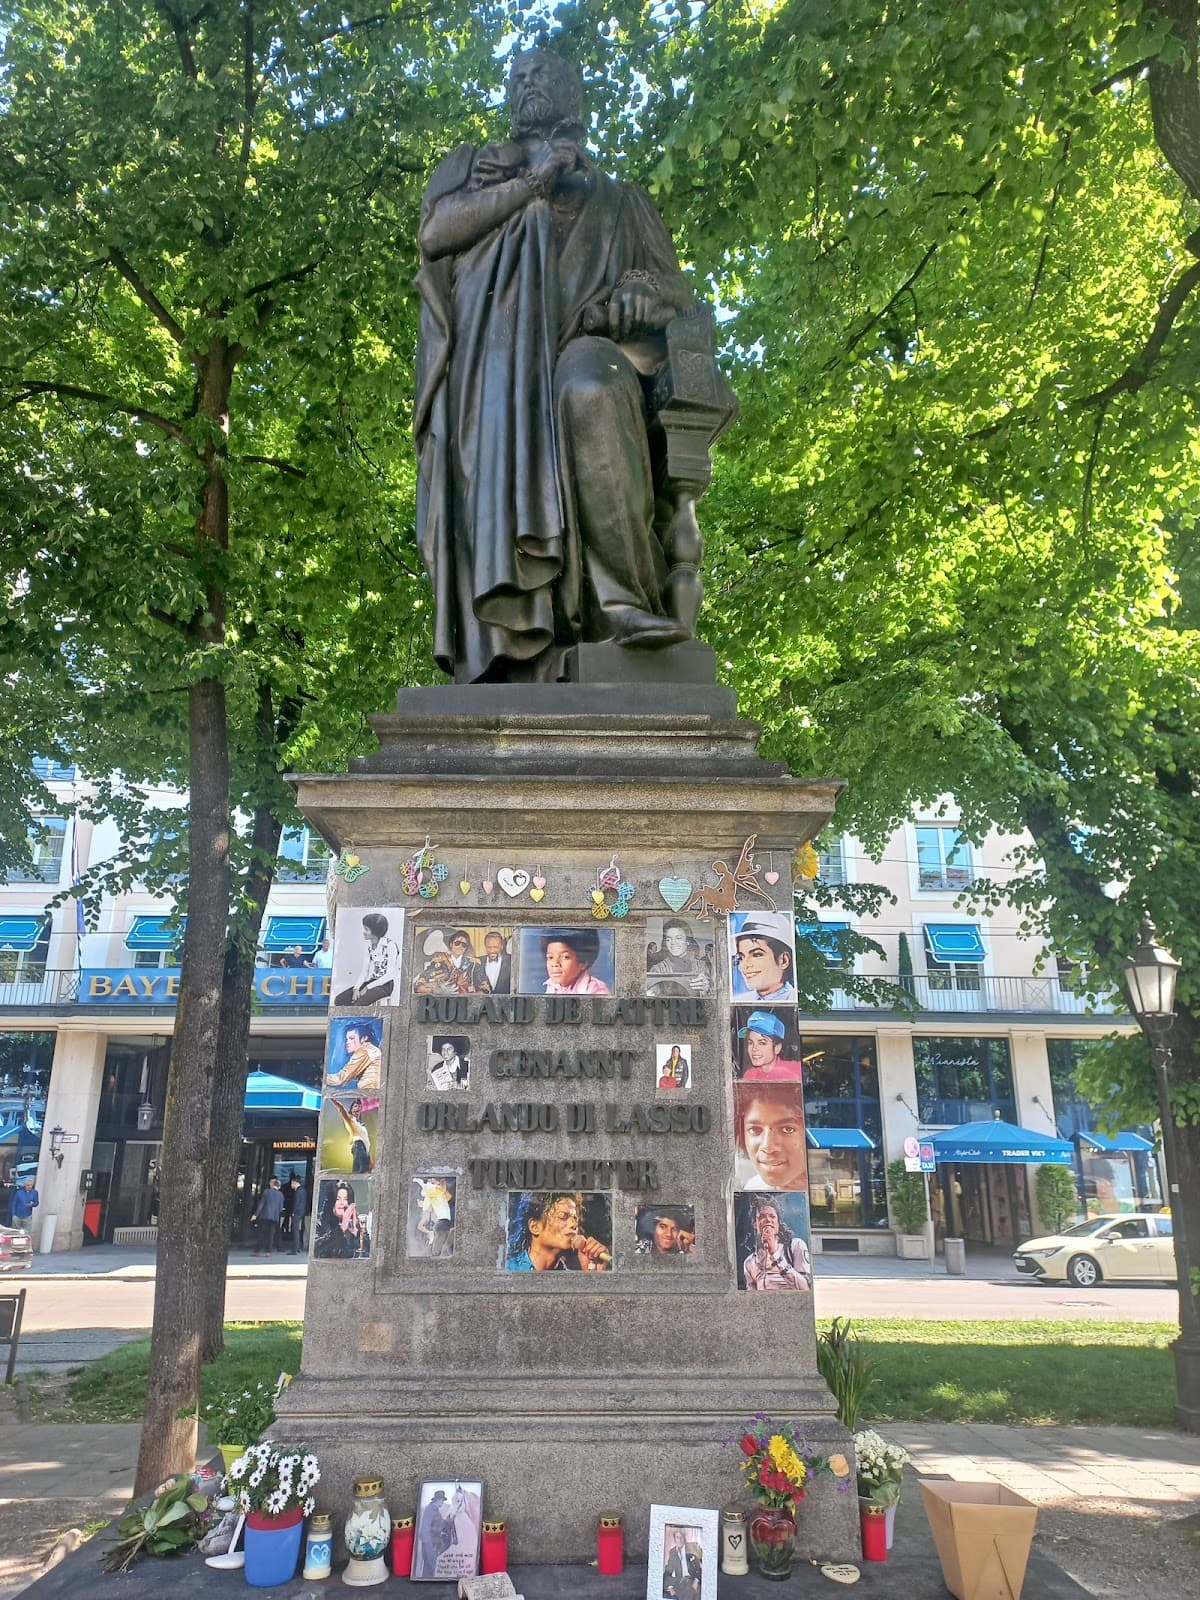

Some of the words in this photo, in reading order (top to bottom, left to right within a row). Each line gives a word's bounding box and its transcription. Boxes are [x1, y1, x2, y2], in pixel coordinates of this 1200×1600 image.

[417, 997, 534, 1024] ROLAND
[545, 997, 582, 1025] DE
[592, 998, 707, 1027] LATTRE
[489, 1049, 634, 1079] GENANNT
[416, 1102, 560, 1132] ORLANDO
[567, 1103, 596, 1133] DI
[605, 1103, 712, 1133] LASSO
[469, 1158, 659, 1190] TONDICHTER
